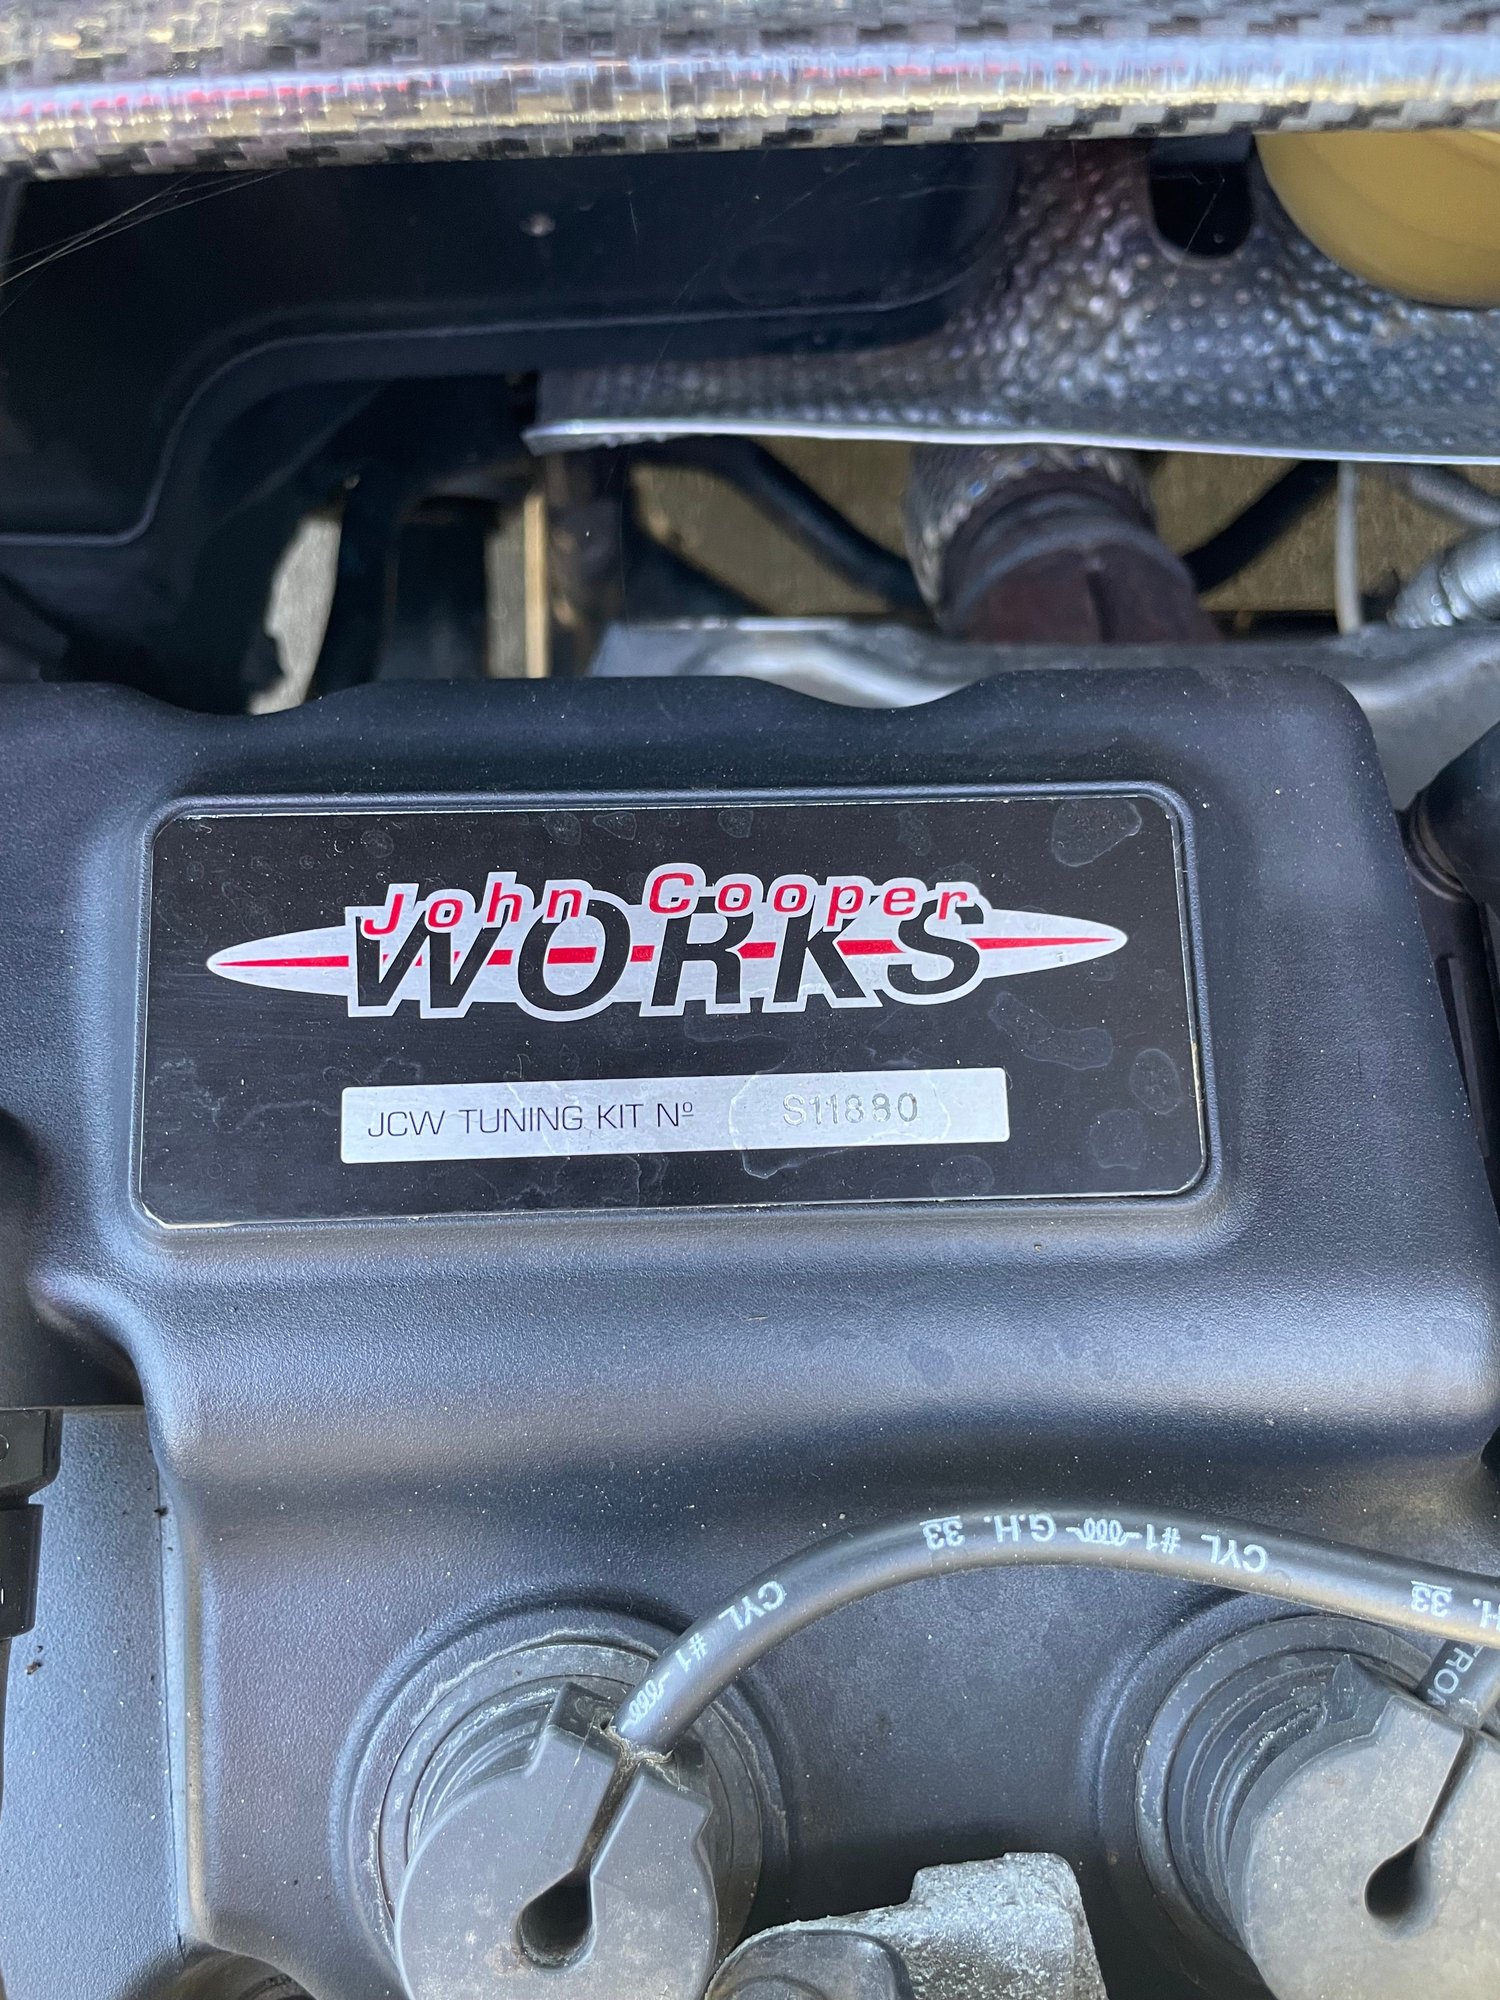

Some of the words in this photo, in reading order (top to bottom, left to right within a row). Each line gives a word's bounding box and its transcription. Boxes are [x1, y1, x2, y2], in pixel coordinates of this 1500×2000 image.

[363, 881, 582, 936] John
[648, 872, 969, 928] Cooper
[356, 895, 985, 1011] WORKS
[368, 1110, 446, 1137] JCW
[458, 1105, 583, 1135] TUNING
[598, 1103, 645, 1130] KIT
[782, 1091, 918, 1126] S11880
[919, 1516, 966, 1550] 33
[983, 1511, 1056, 1544] G.H.
[1200, 1533, 1267, 1574] CYL
[718, 1580, 788, 1631] CYL
[1410, 1580, 1453, 1618] 33
